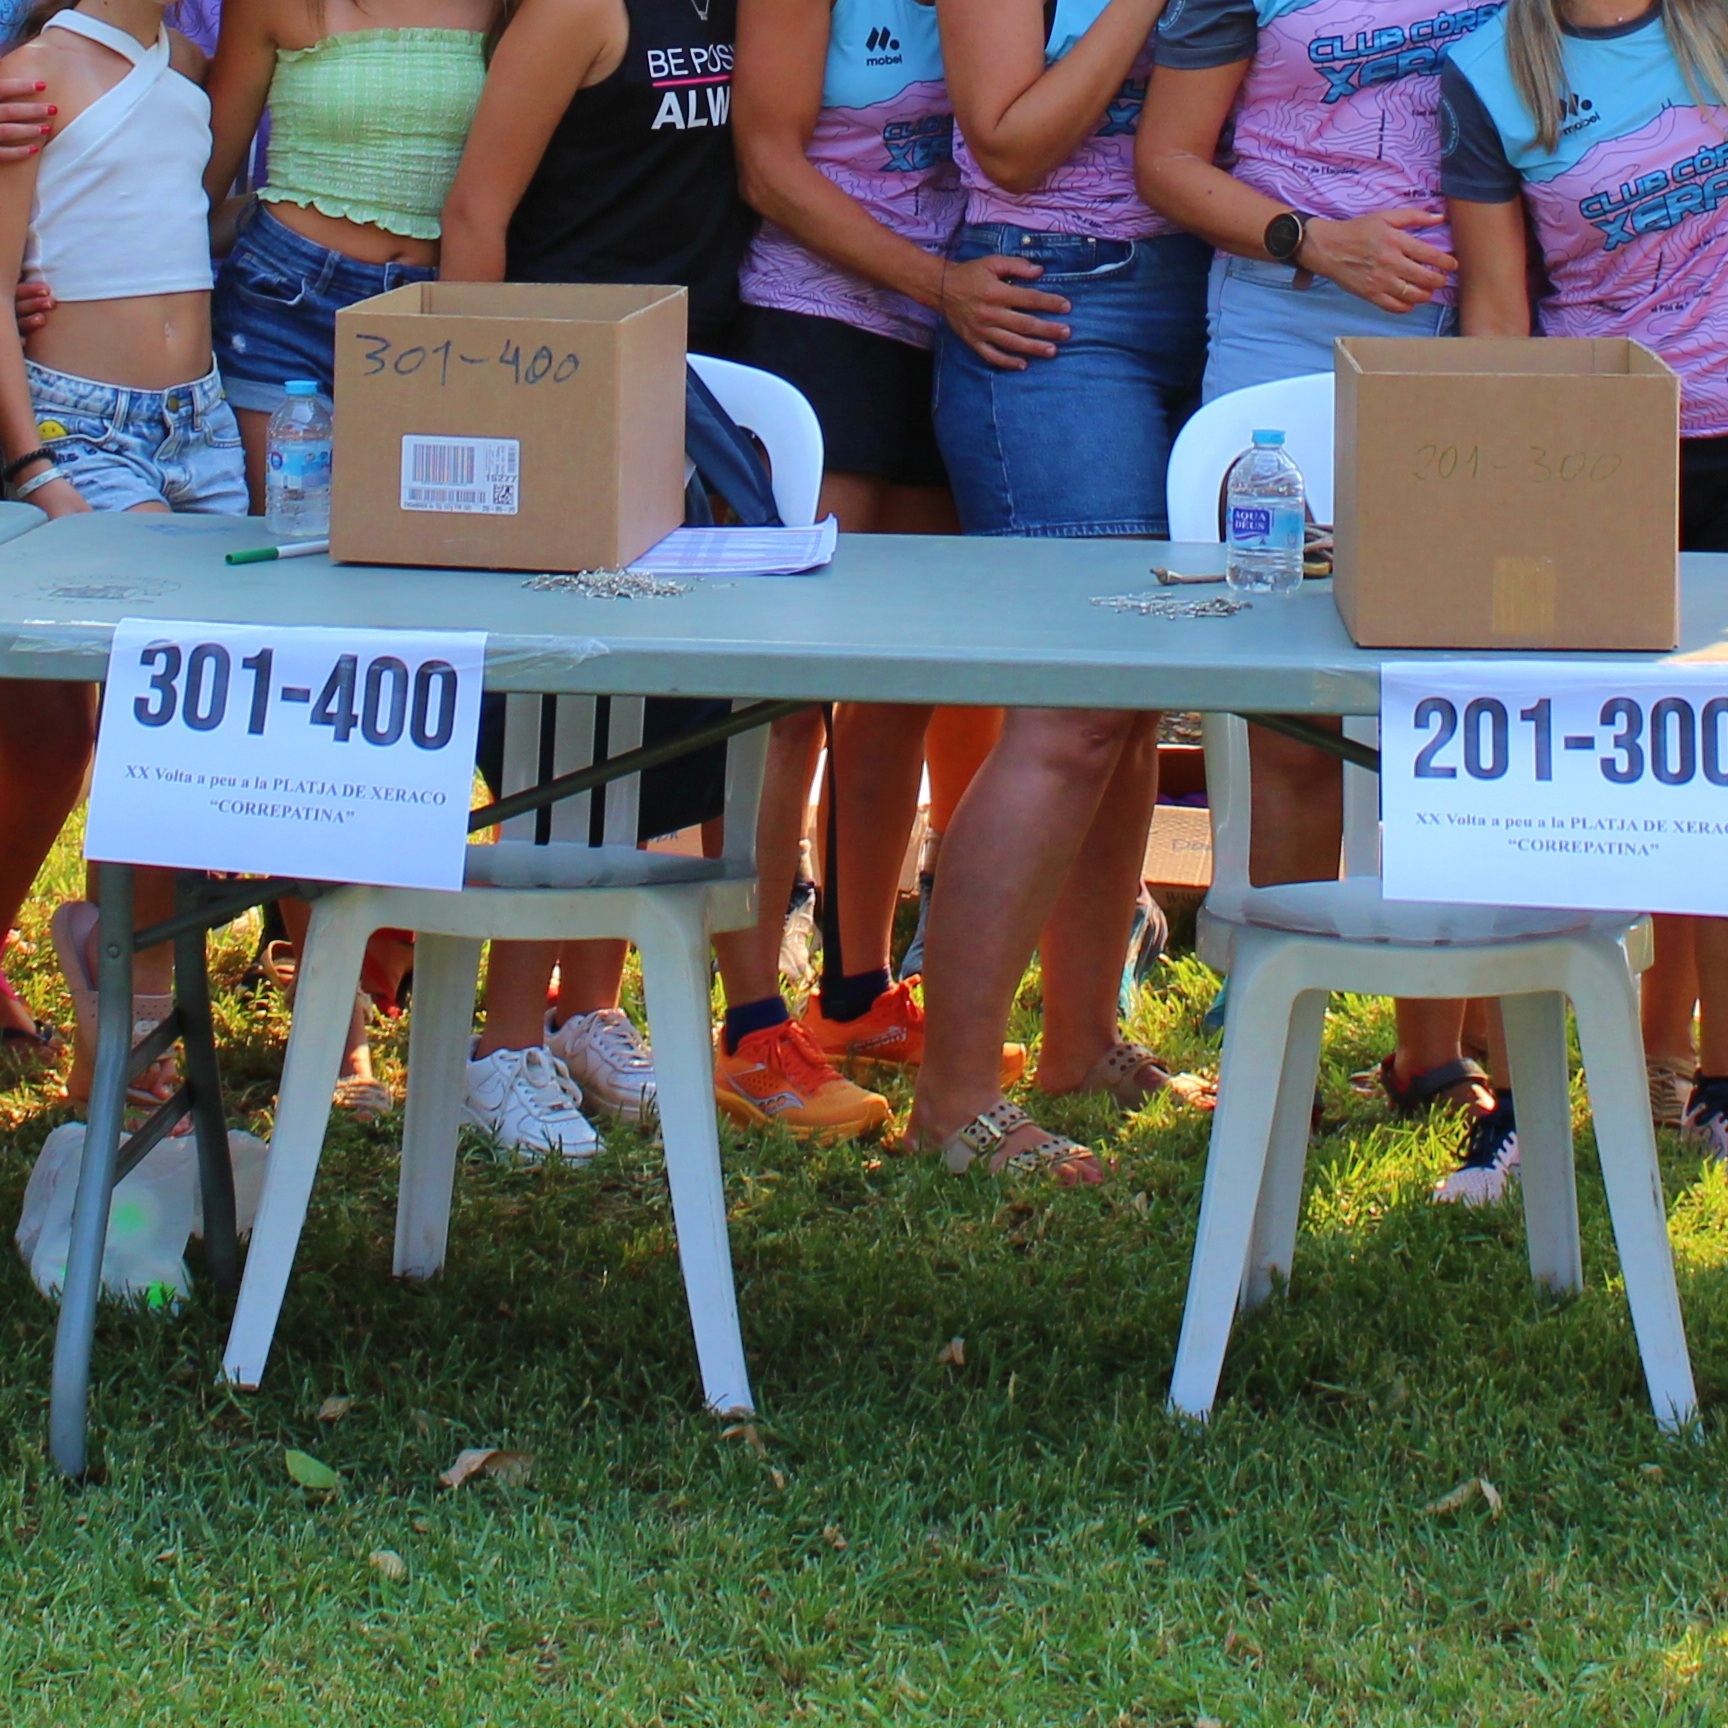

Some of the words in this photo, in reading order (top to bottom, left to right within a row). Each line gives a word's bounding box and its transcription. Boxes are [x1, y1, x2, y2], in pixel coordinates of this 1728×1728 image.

[1308, 26, 1407, 63] CLUB
[647, 49, 689, 78] BE
[867, 53, 903, 66] mobel
[1579, 175, 1668, 220] CLUB
[1234, 511, 1267, 521] AQUA
[1235, 521, 1265, 530] DEUS
[133, 638, 458, 751] 301-400
[125, 765, 150, 780] XX
[154, 766, 193, 784] Volta
[196, 776, 206, 785] a
[209, 776, 236, 791] peu
[240, 779, 250, 789] a
[254, 777, 268, 790] la
[272, 779, 338, 798] PLATJA
[341, 783, 366, 799] DE
[370, 786, 447, 806] XERACO
[1415, 812, 1441, 825] XX
[1445, 813, 1487, 828] Volta
[1491, 819, 1501, 829] a
[1504, 818, 1533, 832] peu
[1537, 820, 1547, 830] a
[1551, 815, 1565, 830] la
[1571, 816, 1639, 833] PLATJA
[1643, 819, 1668, 833] DE
